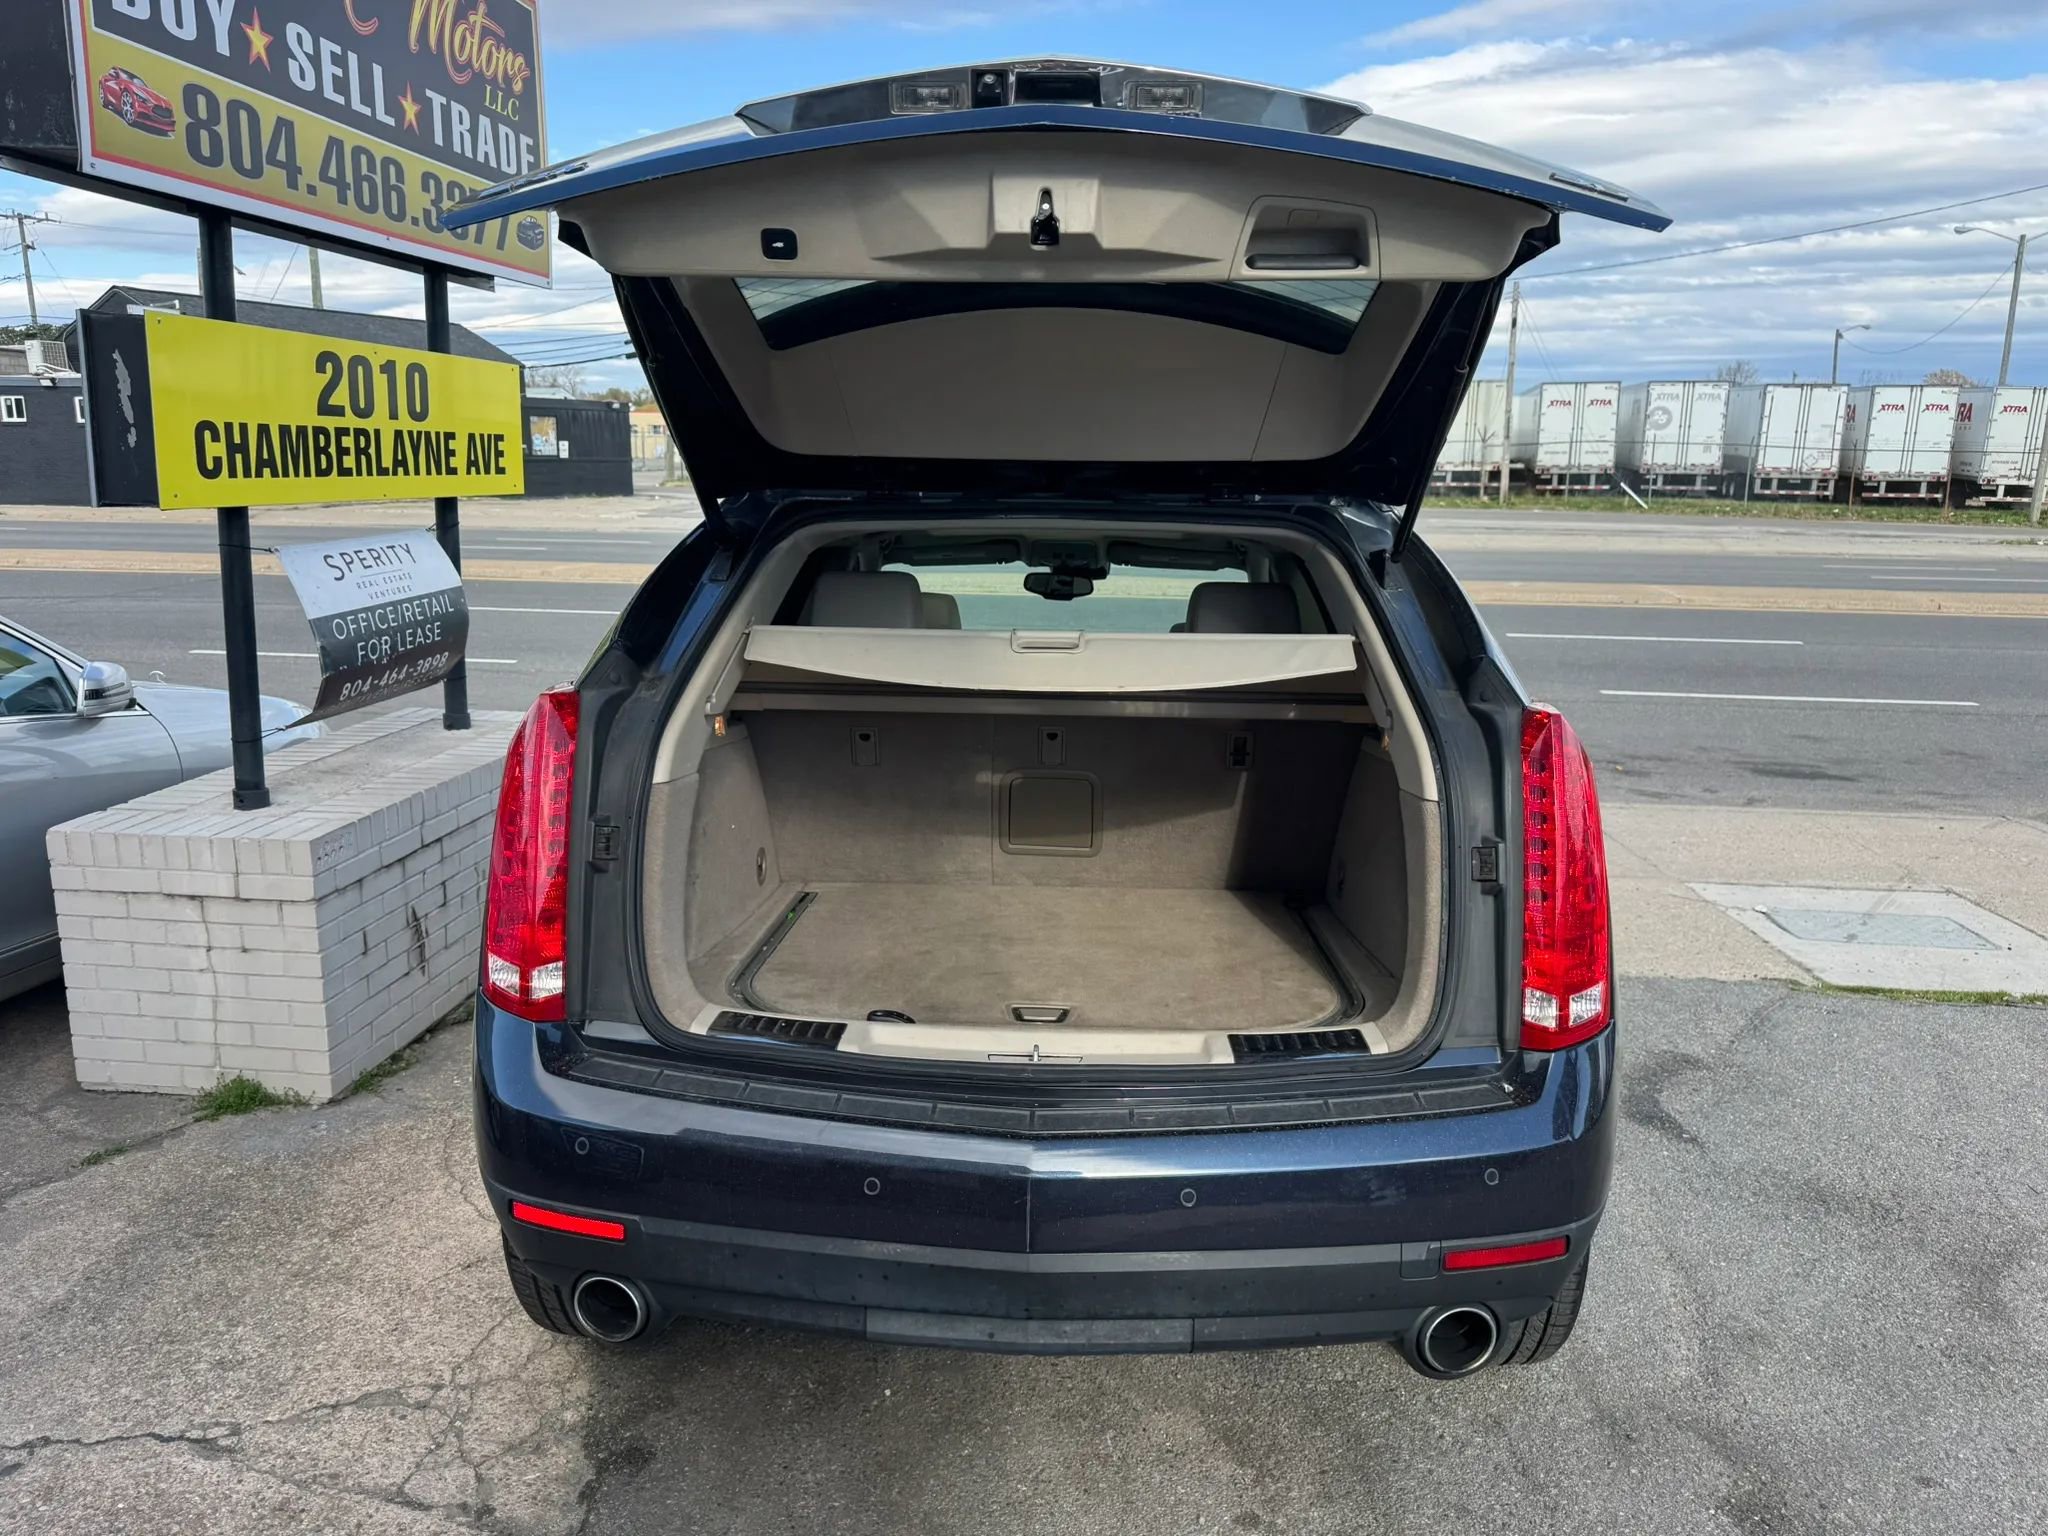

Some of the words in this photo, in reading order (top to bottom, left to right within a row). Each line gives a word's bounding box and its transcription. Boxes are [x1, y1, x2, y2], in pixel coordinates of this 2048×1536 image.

[112, 0, 235, 57] UY
[286, 23, 395, 126] SELL
[408, 0, 530, 94] Motors
[484, 84, 520, 120] LLC
[315, 350, 430, 422] 2010
[1547, 399, 1572, 408] XTRA
[1587, 398, 1613, 408] XTRA
[1877, 403, 1905, 413] XTRA
[1921, 403, 1949, 413] XTRA
[1999, 405, 2028, 414] XTRA
[194, 420, 458, 480] CHAMBERLAYNE
[466, 432, 506, 476] AVE
[323, 543, 417, 581] SPERITY
[356, 577, 379, 590] REAL
[384, 572, 413, 585] ESTATE
[368, 584, 413, 600] VENTURES
[332, 594, 455, 640] OFFICE/RETAIL
[357, 635, 391, 666] FOR
[397, 621, 442, 652] LEASE
[339, 651, 449, 701] 804-464-3898
